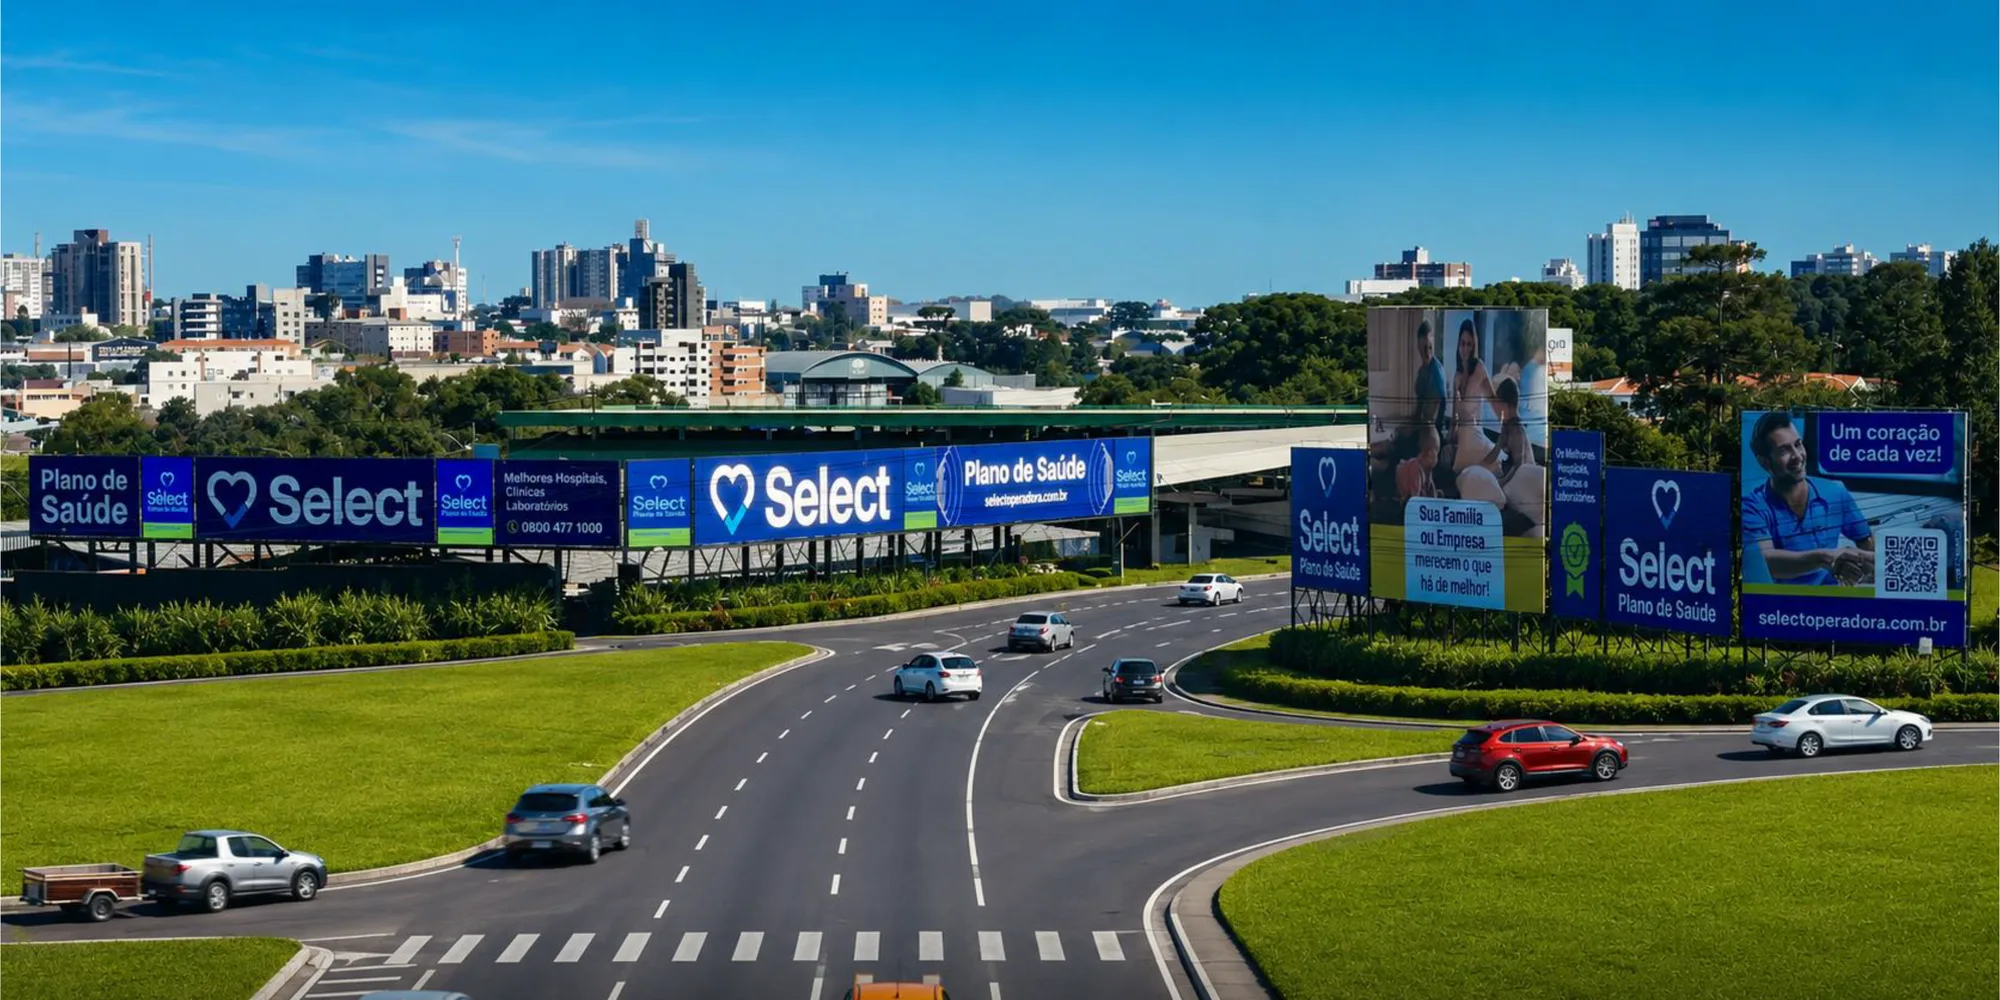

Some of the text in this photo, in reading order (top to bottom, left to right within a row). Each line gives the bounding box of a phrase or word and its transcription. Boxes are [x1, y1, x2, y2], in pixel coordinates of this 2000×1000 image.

[1831, 423, 1940, 446] Um coração
[1829, 444, 1942, 462] de cada vez!
[41, 468, 128, 491] Plano de
[504, 472, 608, 486] Melhores Hospitais,
[965, 453, 1086, 486] Plano de Saúde
[1116, 468, 1147, 482] Select
[765, 466, 891, 528] Select
[906, 481, 936, 496] Select
[41, 493, 128, 525] Saúde
[269, 475, 423, 526] Select
[441, 494, 488, 510] Select
[506, 500, 569, 511] Laboratórios
[633, 495, 686, 510] Select
[1419, 505, 1440, 522] Sua
[521, 522, 603, 534] 0800 477 1000
[1300, 508, 1360, 556] Select
[1421, 529, 1485, 552] ou Empresa
[1323, 559, 1334, 578] de
[1415, 554, 1492, 577] merecem o que
[1619, 537, 1716, 595] Select
[1420, 574, 1490, 597] há de melhor!
[1618, 593, 1717, 623] Plano de Saúde
[1758, 609, 1948, 632] selectoperadora.com.br
